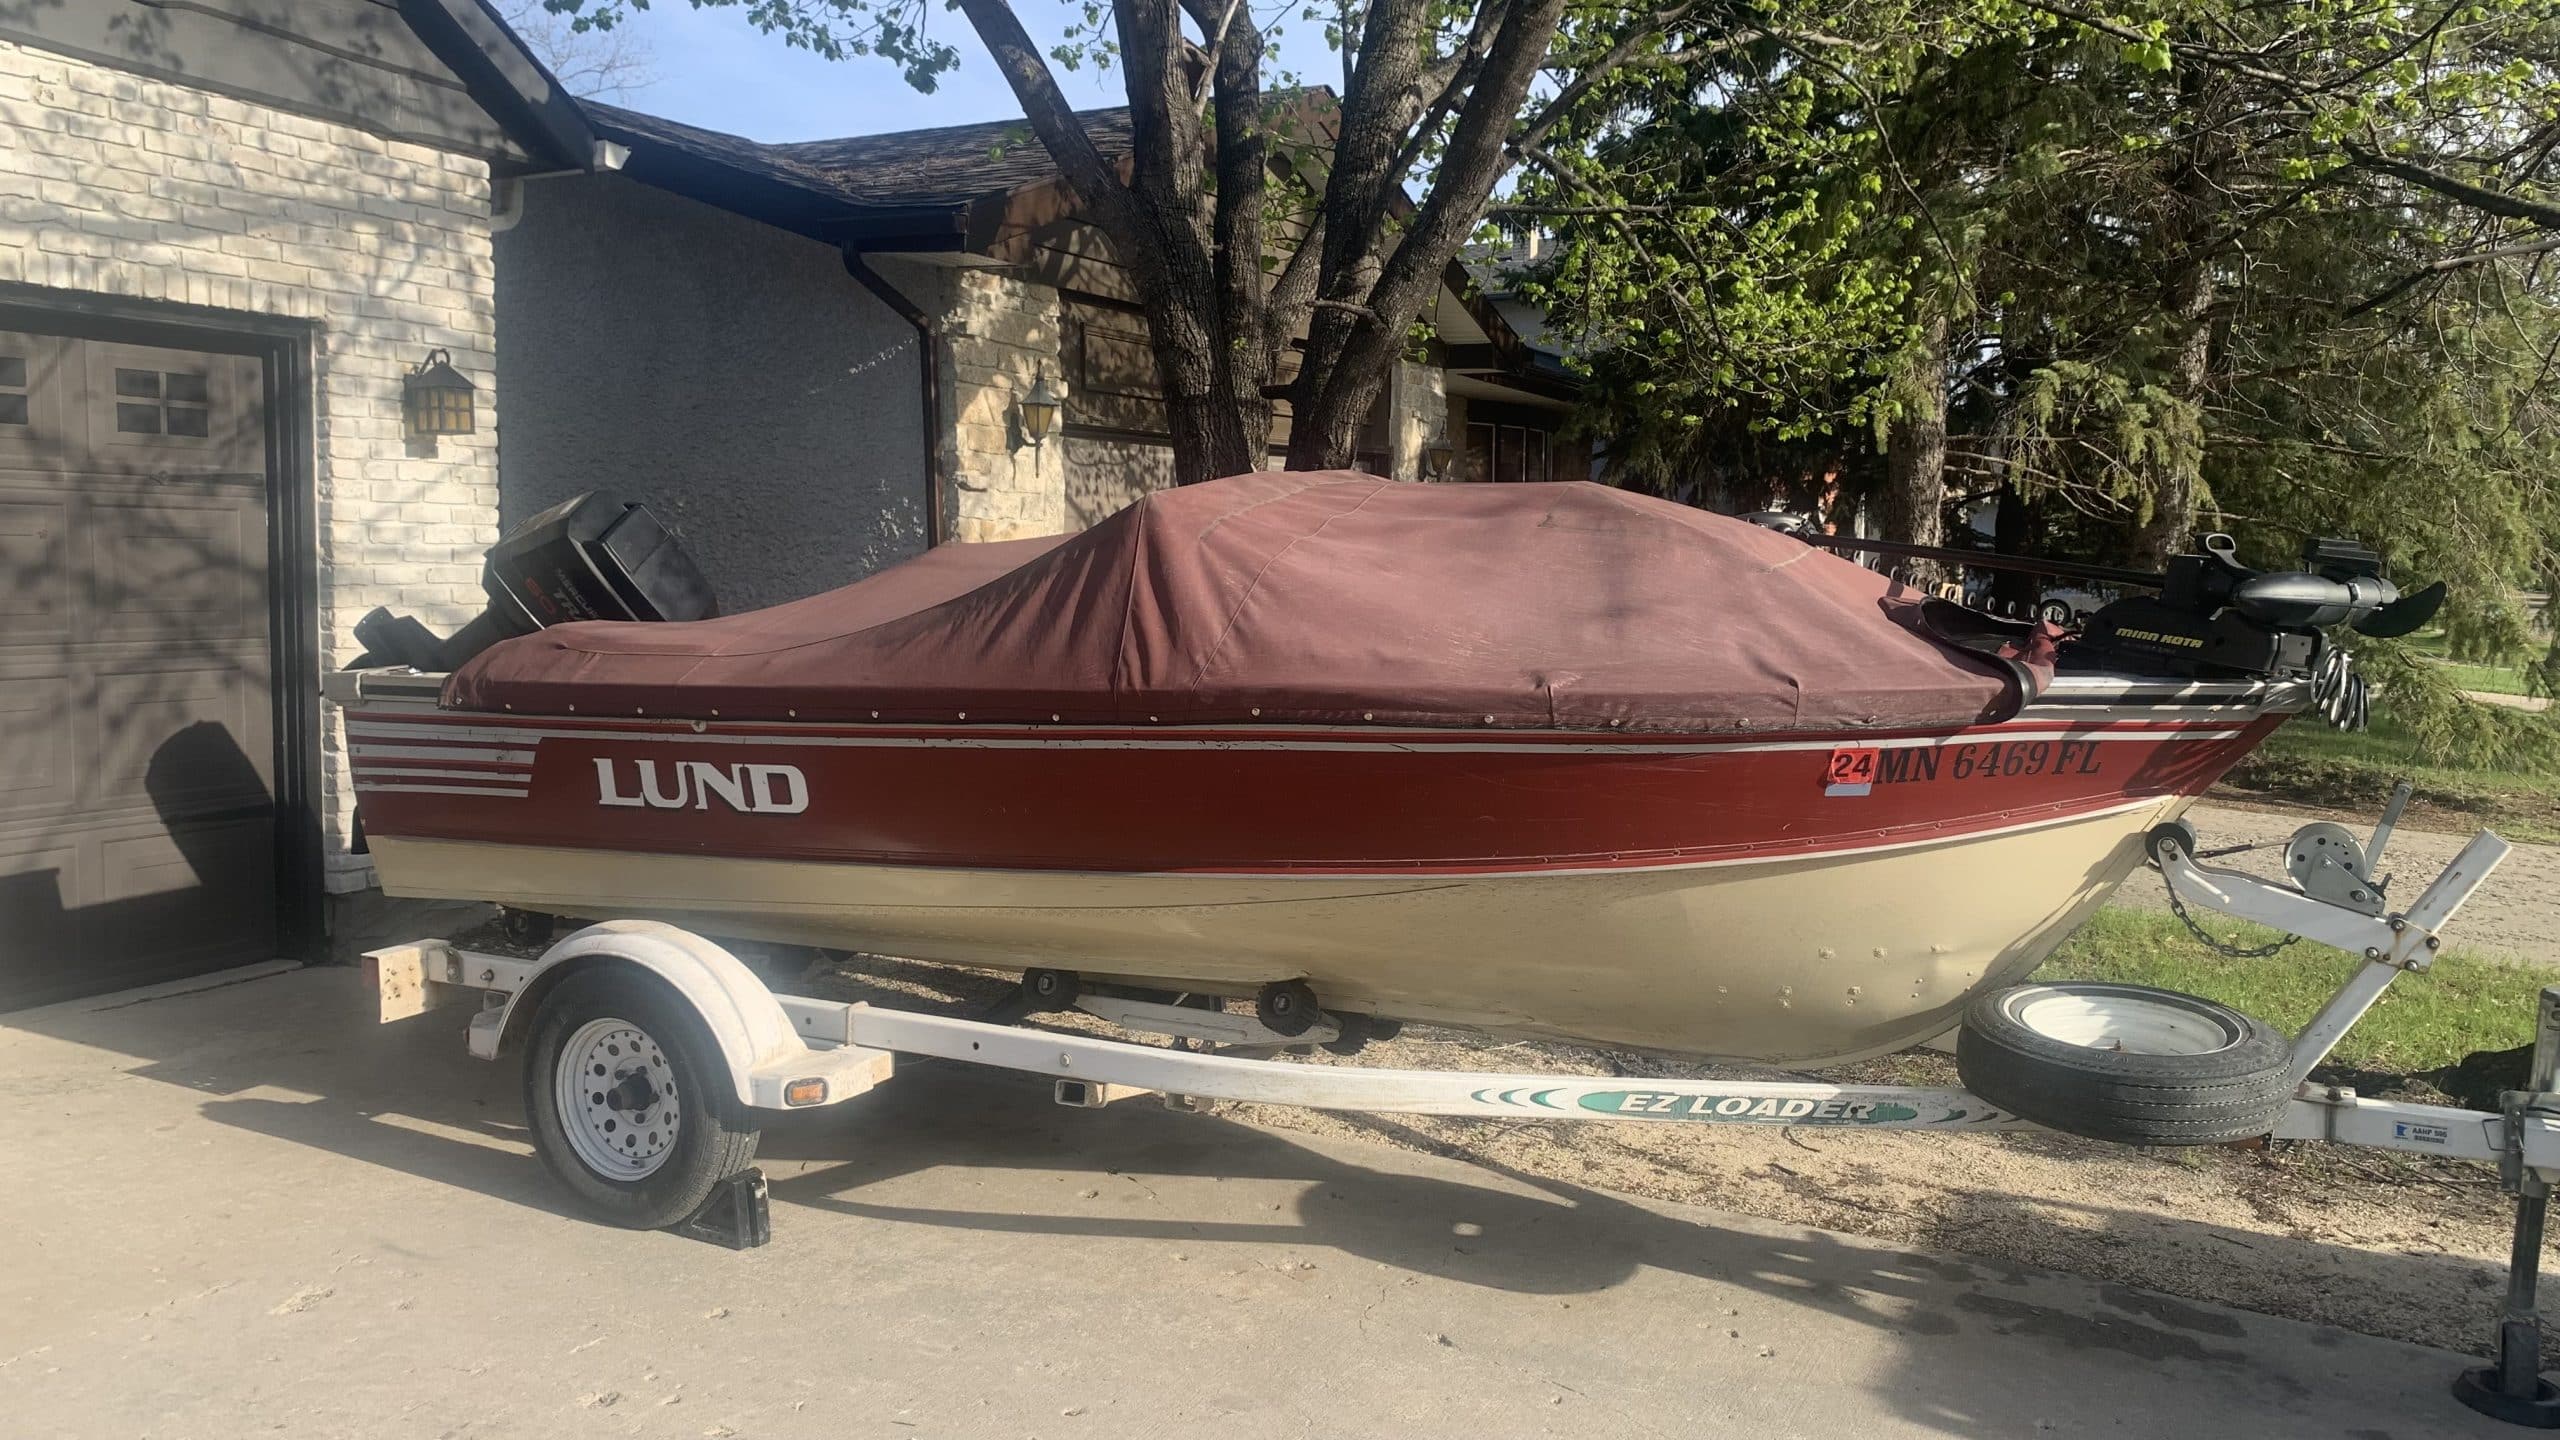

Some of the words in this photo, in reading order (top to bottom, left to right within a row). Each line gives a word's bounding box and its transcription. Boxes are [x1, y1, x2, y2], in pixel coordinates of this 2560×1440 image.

[555, 567, 601, 618] MERCUR
[2160, 634, 2204, 649] KOTA
[1834, 753, 1872, 778] 24
[1874, 745, 1943, 785] MN
[1952, 741, 2050, 780] 6469
[2051, 740, 2103, 775] FL
[592, 757, 810, 814] LUND
[1618, 1094, 1679, 1113] EZ
[1687, 1095, 1877, 1120] LOADER
